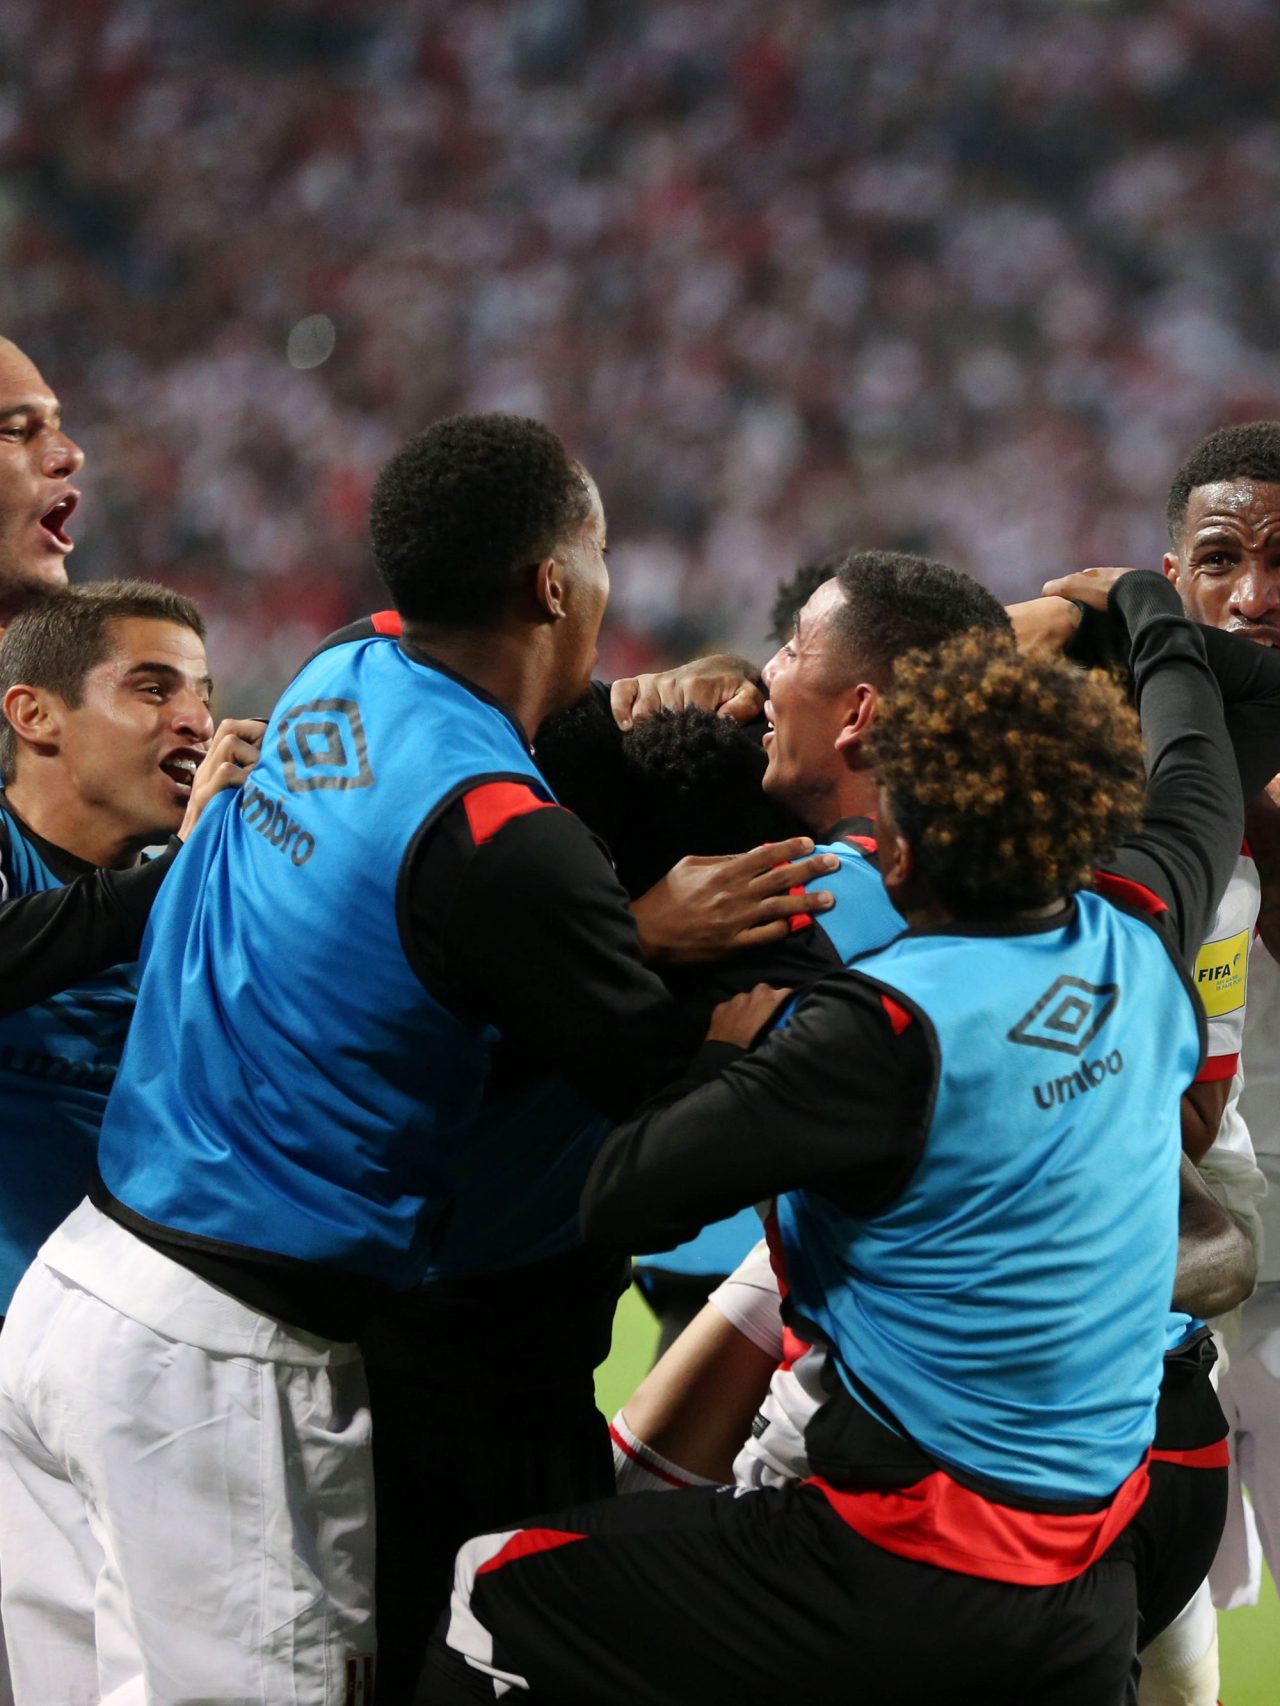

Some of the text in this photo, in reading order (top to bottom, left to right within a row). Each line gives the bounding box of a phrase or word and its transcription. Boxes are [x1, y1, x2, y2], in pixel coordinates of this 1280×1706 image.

[242, 782, 315, 867] mbro
[1198, 963, 1231, 982] FIFA
[1033, 1049, 1124, 1110] umbo
